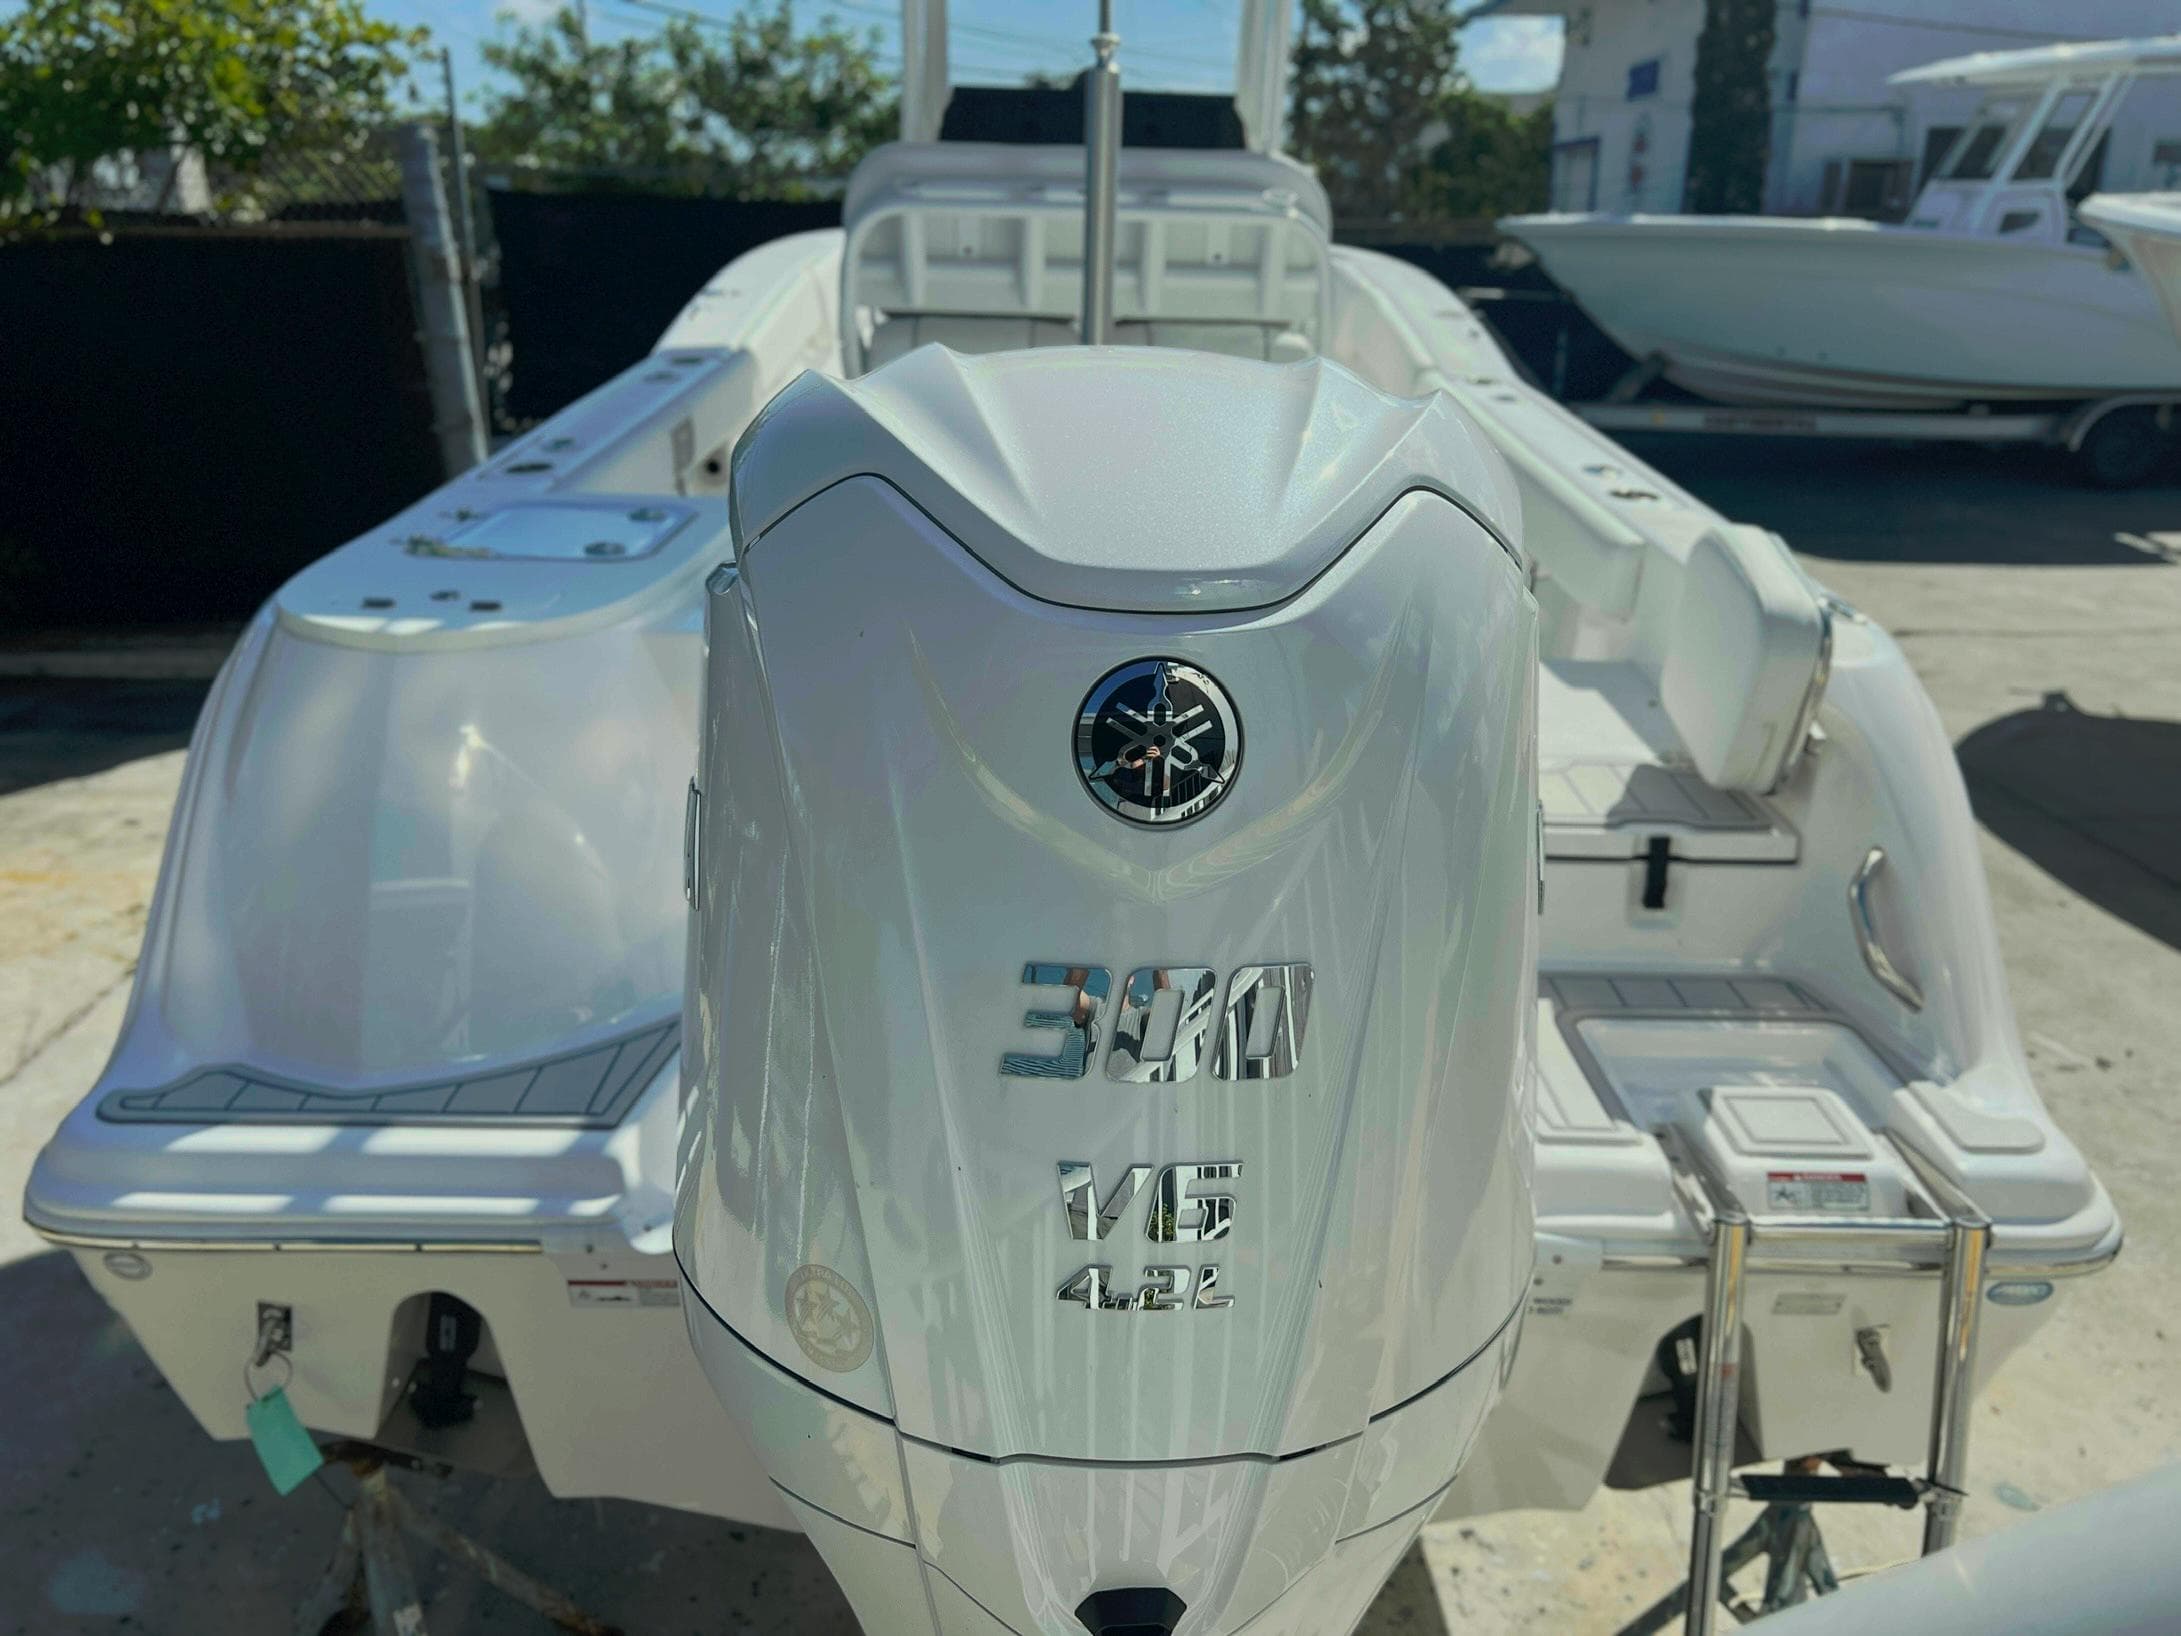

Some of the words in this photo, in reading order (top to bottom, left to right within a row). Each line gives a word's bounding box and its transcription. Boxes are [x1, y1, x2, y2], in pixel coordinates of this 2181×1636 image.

[1000, 962, 1315, 1083] 300
[1056, 1160, 1244, 1243] V6
[1055, 1263, 1236, 1311] 4.2L
